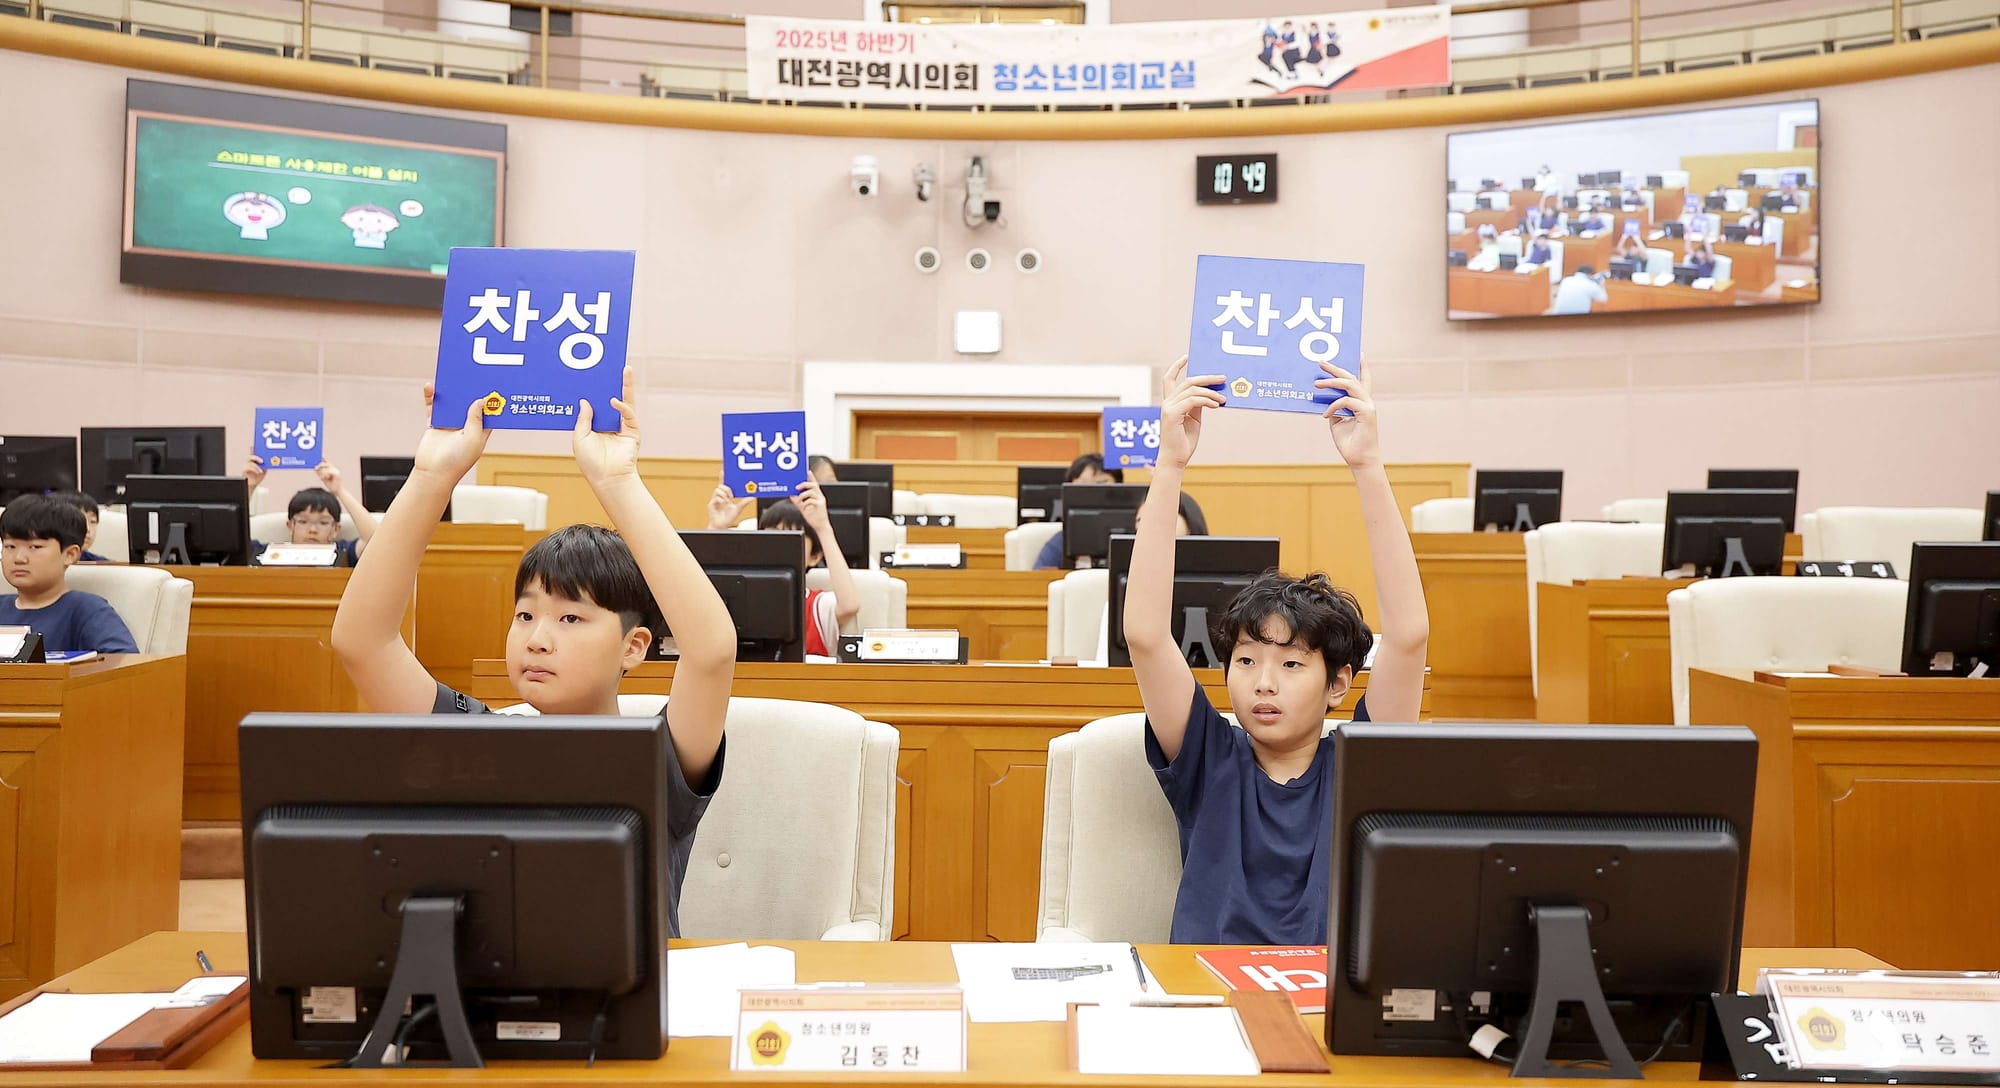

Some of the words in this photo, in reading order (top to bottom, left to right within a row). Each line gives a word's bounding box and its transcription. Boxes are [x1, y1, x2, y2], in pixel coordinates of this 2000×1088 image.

[776, 30, 848, 52] 2025년
[857, 32, 916, 54] 하반기
[778, 58, 979, 91] 대전광역시의회
[993, 60, 1197, 92] 청소년의회교실
[216, 149, 281, 169] 스마트폰
[1241, 162, 1266, 192] 49
[463, 288, 611, 370] 찬성
[1211, 290, 1344, 363] 찬성
[1256, 388, 1314, 401] 청소년의회교실
[510, 403, 573, 415] 청소년의회교실
[262, 420, 317, 450] 찬성
[1111, 419, 1160, 448] 찬성
[732, 431, 799, 471] 찬성
[801, 1022, 872, 1036] 청소년의원
[1850, 1008, 1926, 1024] 청년의원
[840, 1045, 920, 1067] 김동찬
